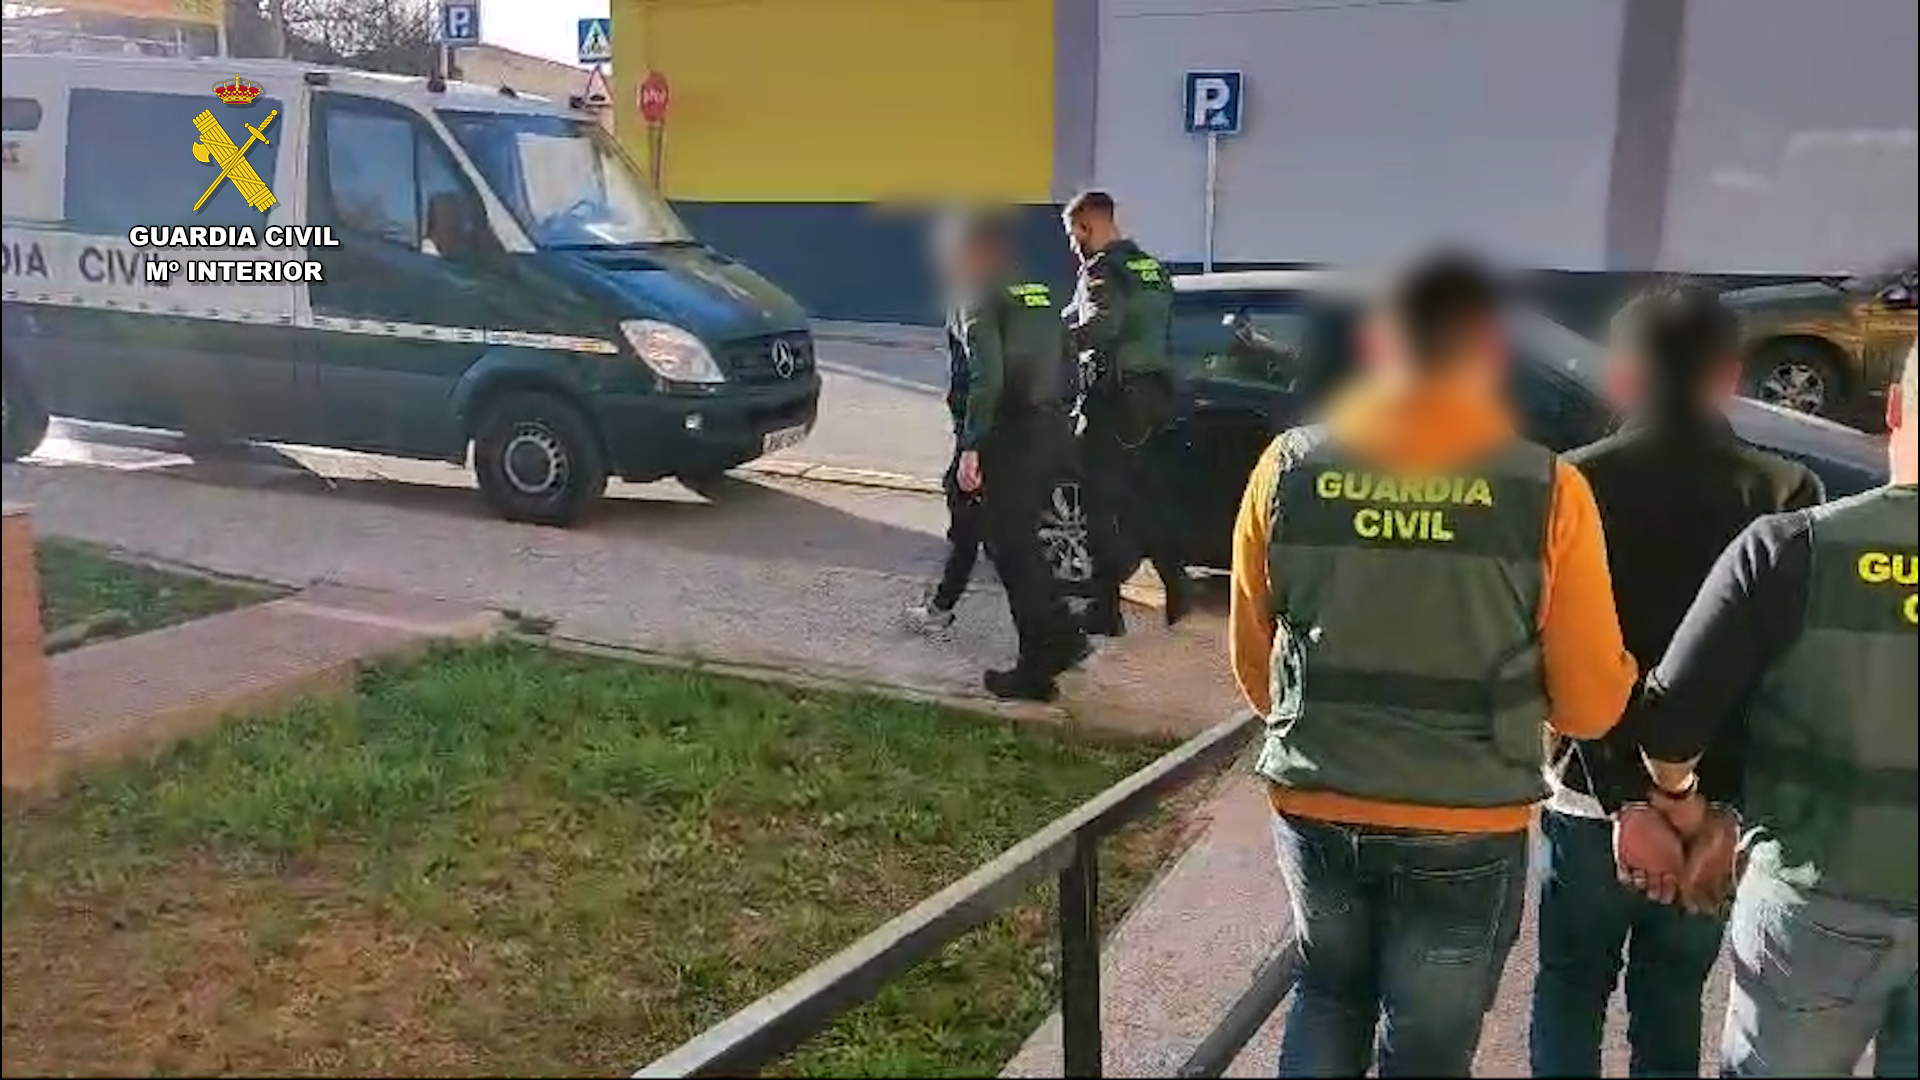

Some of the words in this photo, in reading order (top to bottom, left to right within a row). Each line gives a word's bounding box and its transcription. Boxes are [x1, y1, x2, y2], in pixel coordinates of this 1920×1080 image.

[450, 7, 471, 37] P
[1195, 78, 1230, 126] P
[1317, 471, 1493, 507] GUARDIA
[1354, 508, 1454, 541] CIVIL
[1858, 552, 1918, 584] GU
